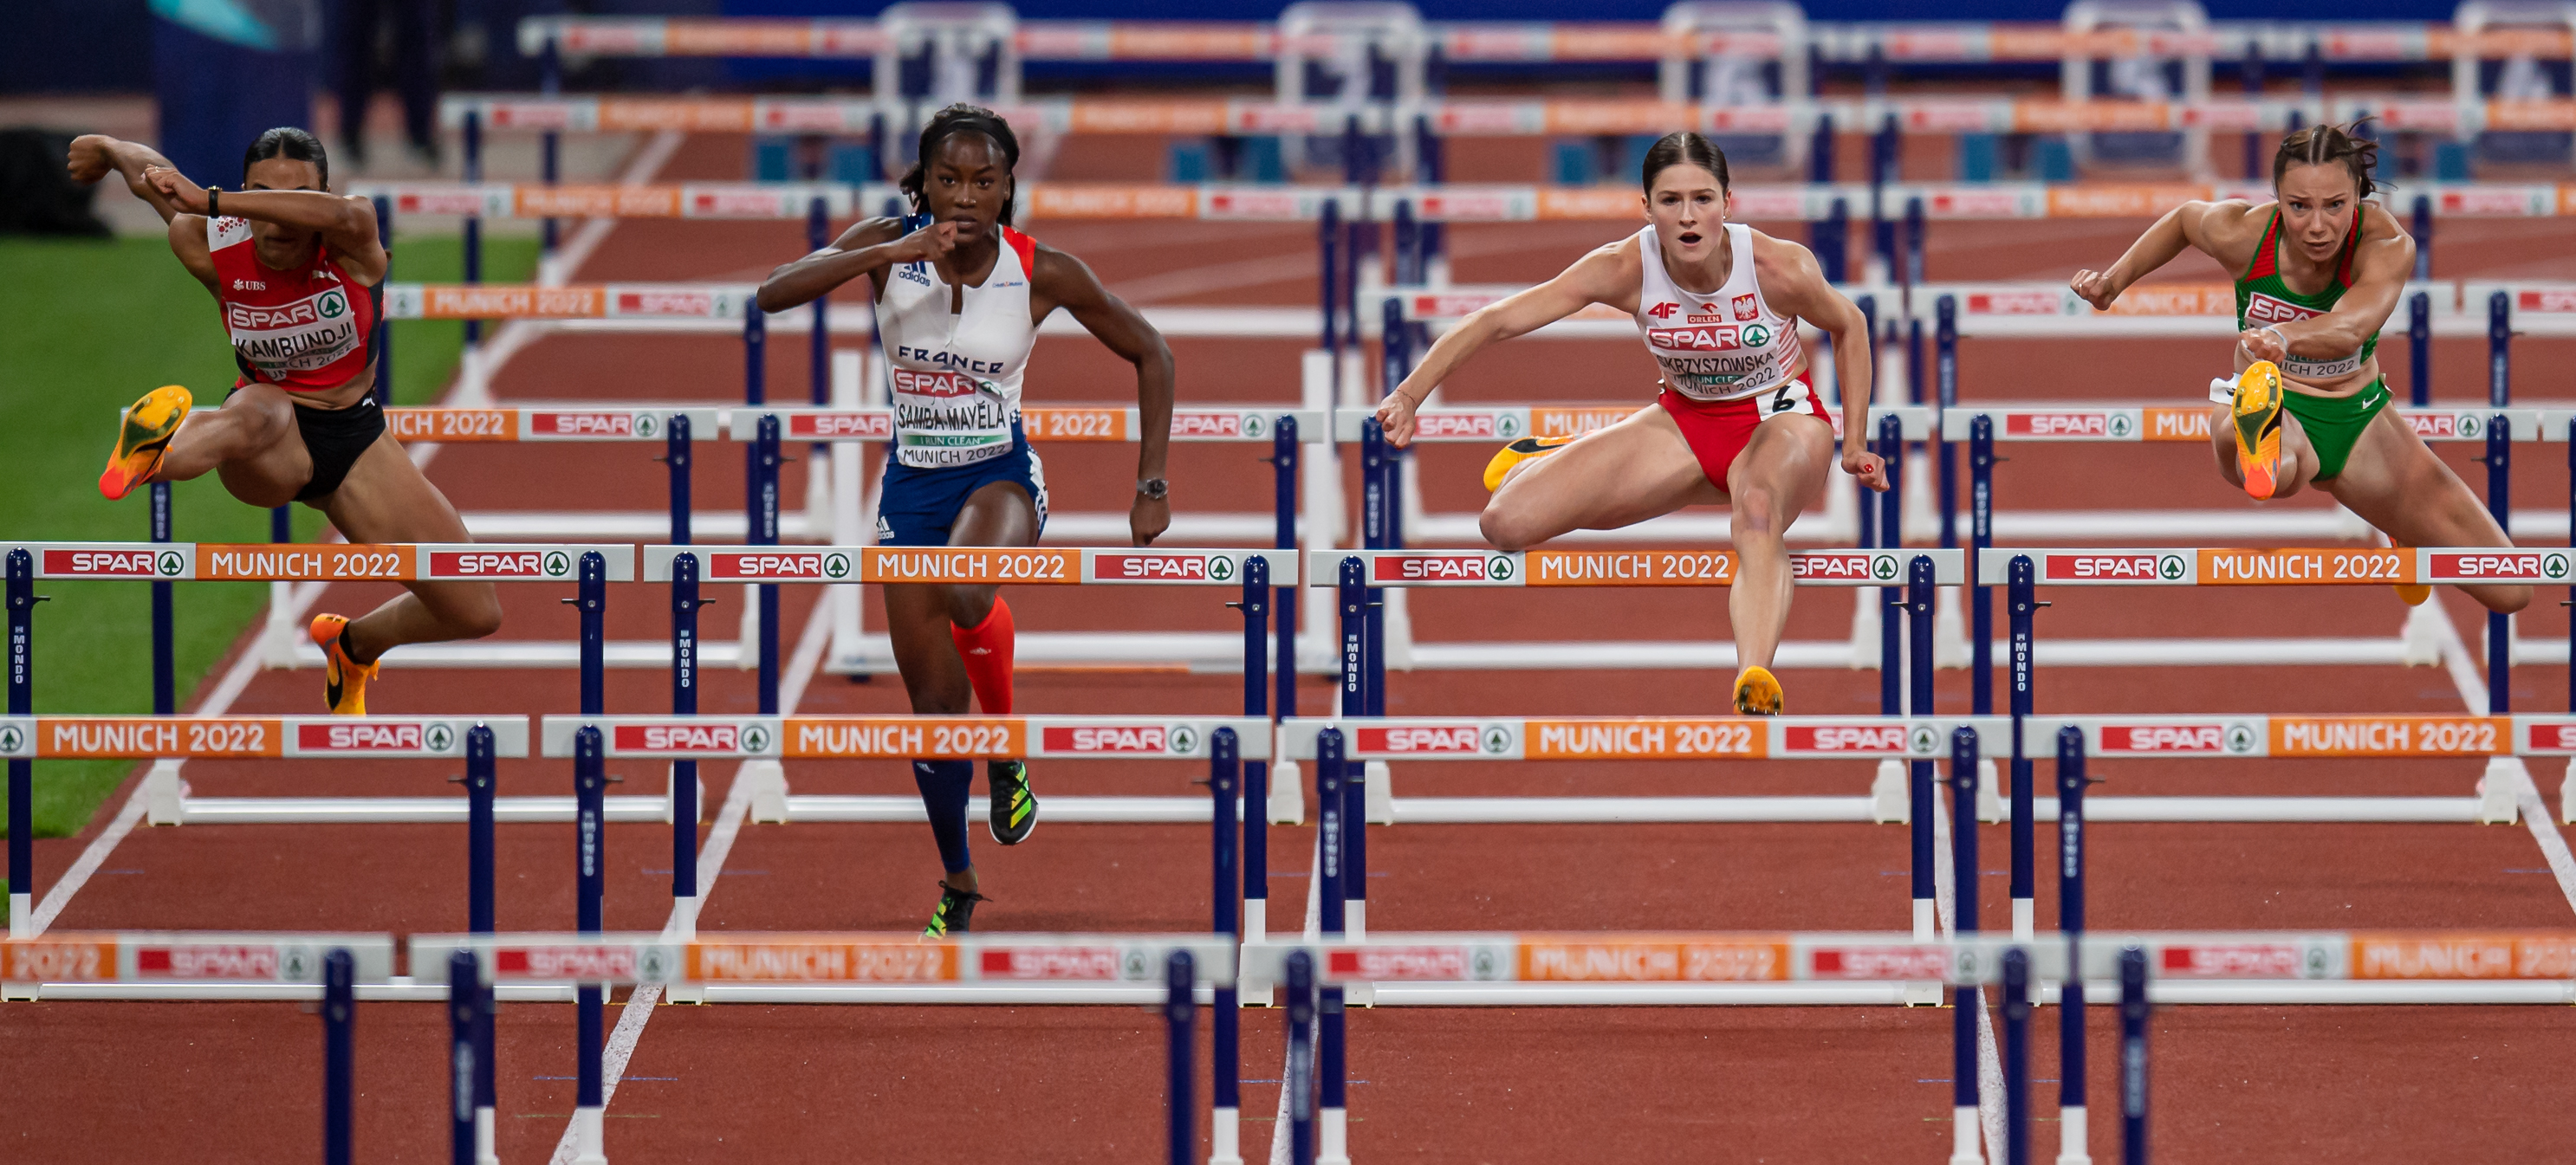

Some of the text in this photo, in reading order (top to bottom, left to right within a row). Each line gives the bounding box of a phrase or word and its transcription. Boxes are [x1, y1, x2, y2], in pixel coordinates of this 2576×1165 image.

[245, 281, 266, 291] UBS
[899, 270, 931, 287] adidas
[232, 303, 314, 328] SPAR
[1648, 301, 1680, 320] 4F
[2251, 298, 2311, 322] SPA
[235, 322, 352, 359] KAMBUNDJI
[1651, 328, 1738, 348] SPAR
[899, 346, 1004, 373] FRANCE
[1657, 352, 1775, 373] SKRZYSZOWSKA
[2316, 359, 2355, 376] 2022
[896, 372, 974, 394] SPAR
[1736, 366, 1776, 392] 2022
[1772, 385, 1796, 413] 6
[442, 412, 503, 436] 2022
[556, 415, 631, 435] SPAR
[814, 417, 890, 436] SPAR
[1051, 413, 1113, 437] 2022
[1418, 417, 1492, 436] SPAR
[2031, 417, 2105, 435] SPAR
[925, 437, 944, 445] RUN
[904, 444, 1006, 463] MUNICH 2022
[72, 554, 154, 575] SPAR
[211, 553, 401, 577] MUNICH 2022
[458, 555, 540, 575] SPAR
[738, 557, 821, 576] SPAR
[877, 555, 1065, 579] MUNICH 2022
[1123, 558, 1204, 578] SPAR
[1402, 560, 1484, 579] SPAR
[1541, 556, 1729, 580] MUNICH 2022
[1791, 557, 1868, 576] SPAR
[2073, 557, 2157, 576] SPAR
[2212, 554, 2401, 579] MUNICH 2022
[2457, 557, 2540, 575] SPAR
[13, 635, 25, 684] MONDO
[679, 639, 691, 688] MONDO
[1347, 644, 1359, 692] MONDO
[2015, 643, 2027, 691] MONDO
[54, 724, 266, 752] MUNICH 2022
[328, 727, 419, 748] SPAR
[645, 727, 736, 749] SPAR
[799, 725, 1010, 754] MUNICH 2022
[1072, 728, 1165, 750] SPAR
[1386, 728, 1478, 751] SPAR
[1541, 726, 1753, 754] MUNICH 2022
[1813, 728, 1904, 750] SPAR
[2130, 728, 2222, 750] SPAR
[2284, 724, 2497, 753] MUNICH 2022
